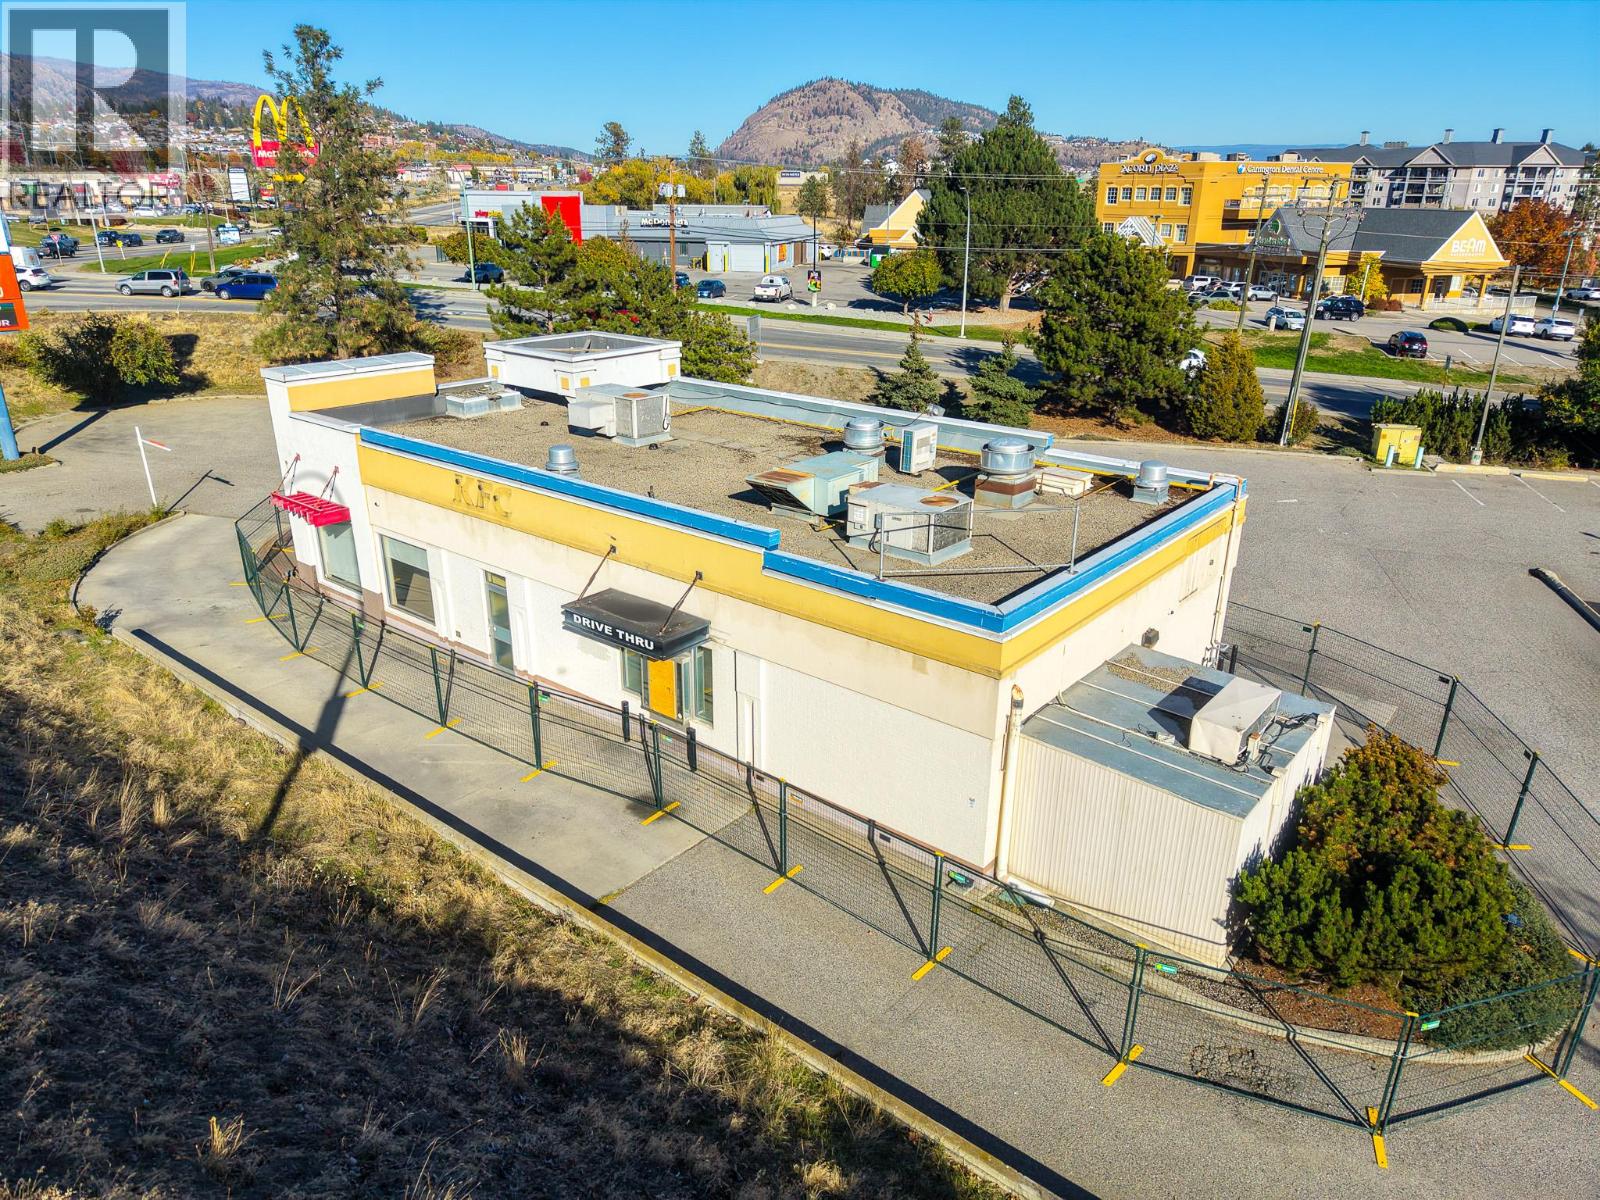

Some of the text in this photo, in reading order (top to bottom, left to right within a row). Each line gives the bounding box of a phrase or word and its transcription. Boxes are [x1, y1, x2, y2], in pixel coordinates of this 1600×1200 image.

[1302, 165, 1324, 174] Centre
[1452, 238, 1486, 251] BEAM
[573, 614, 655, 650] DRIVE THRU
